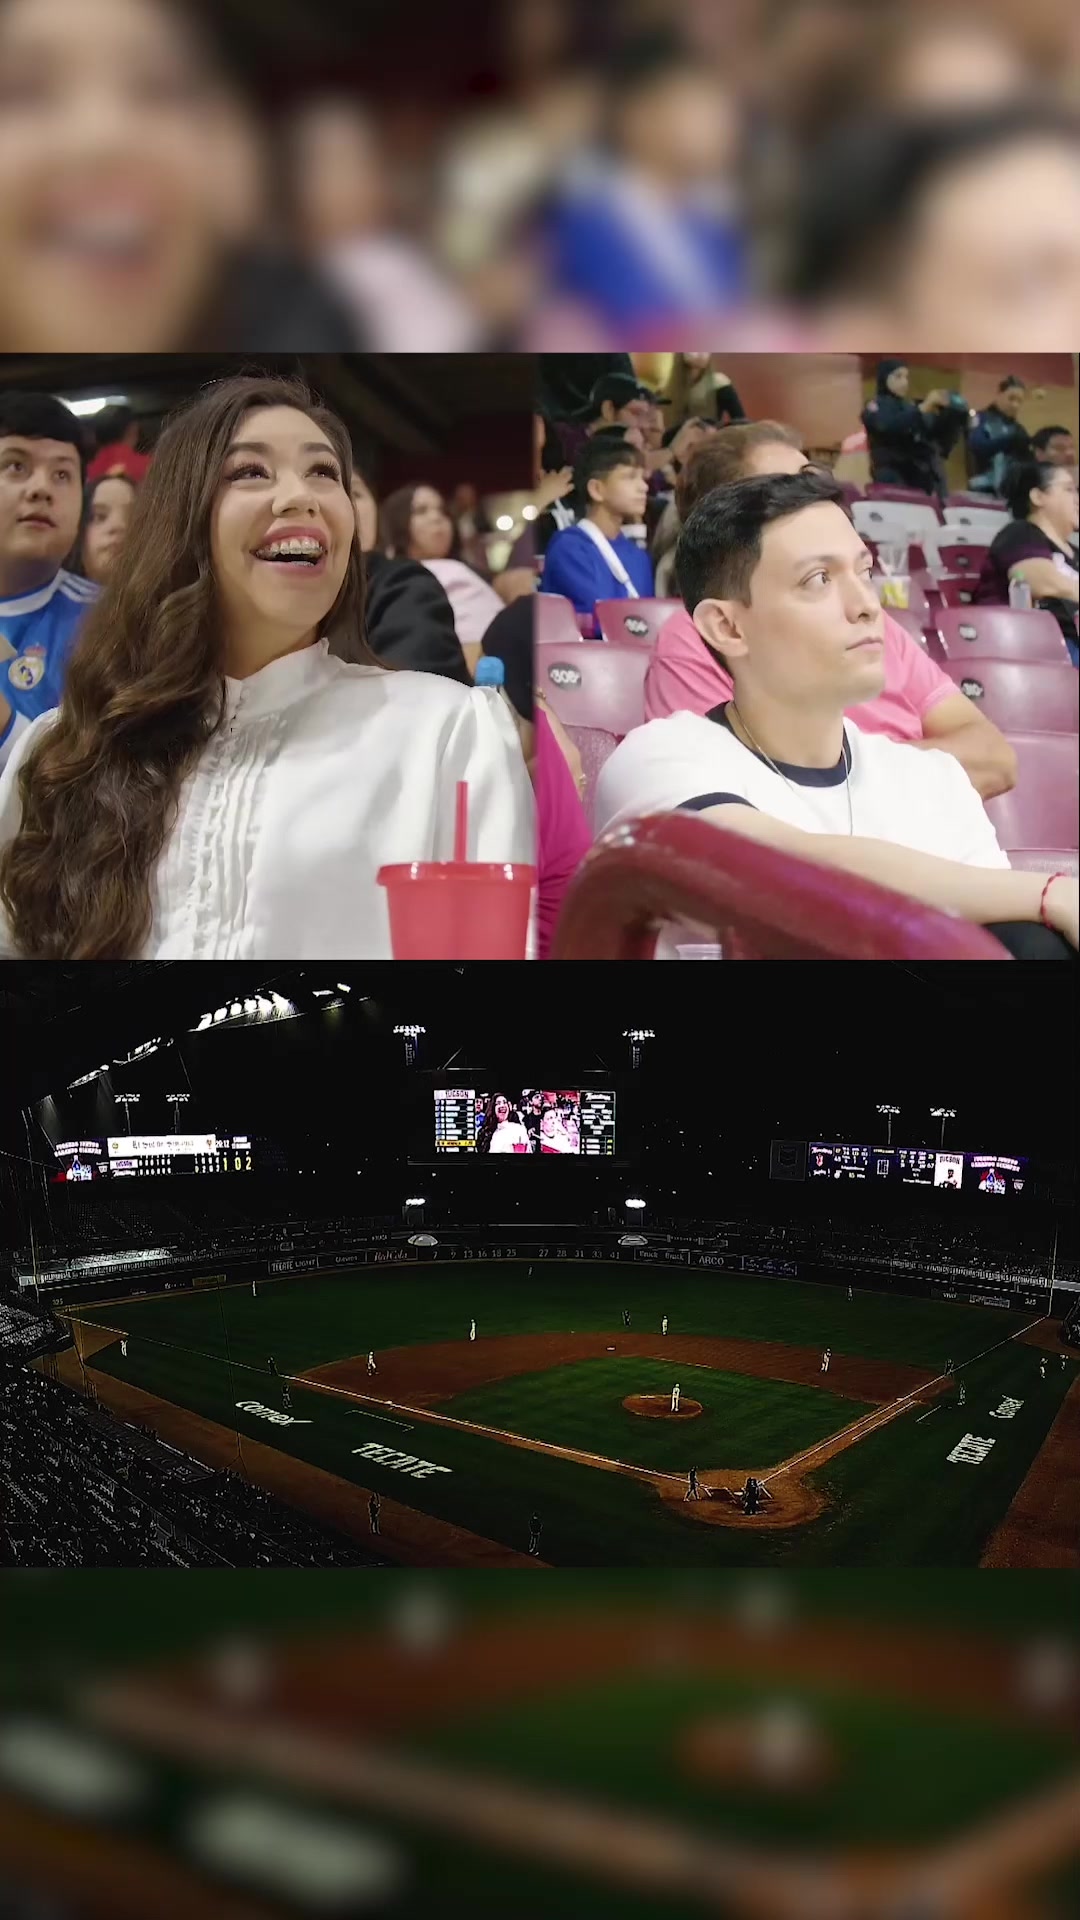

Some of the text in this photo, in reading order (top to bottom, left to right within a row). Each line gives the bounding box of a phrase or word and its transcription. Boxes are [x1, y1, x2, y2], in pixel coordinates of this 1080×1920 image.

[506, 1248, 517, 1257] 25
[538, 1249, 549, 1257] 27
[271, 1260, 294, 1272] TECATE
[698, 1255, 725, 1266] ARCO
[350, 1442, 453, 1479] TECATE
